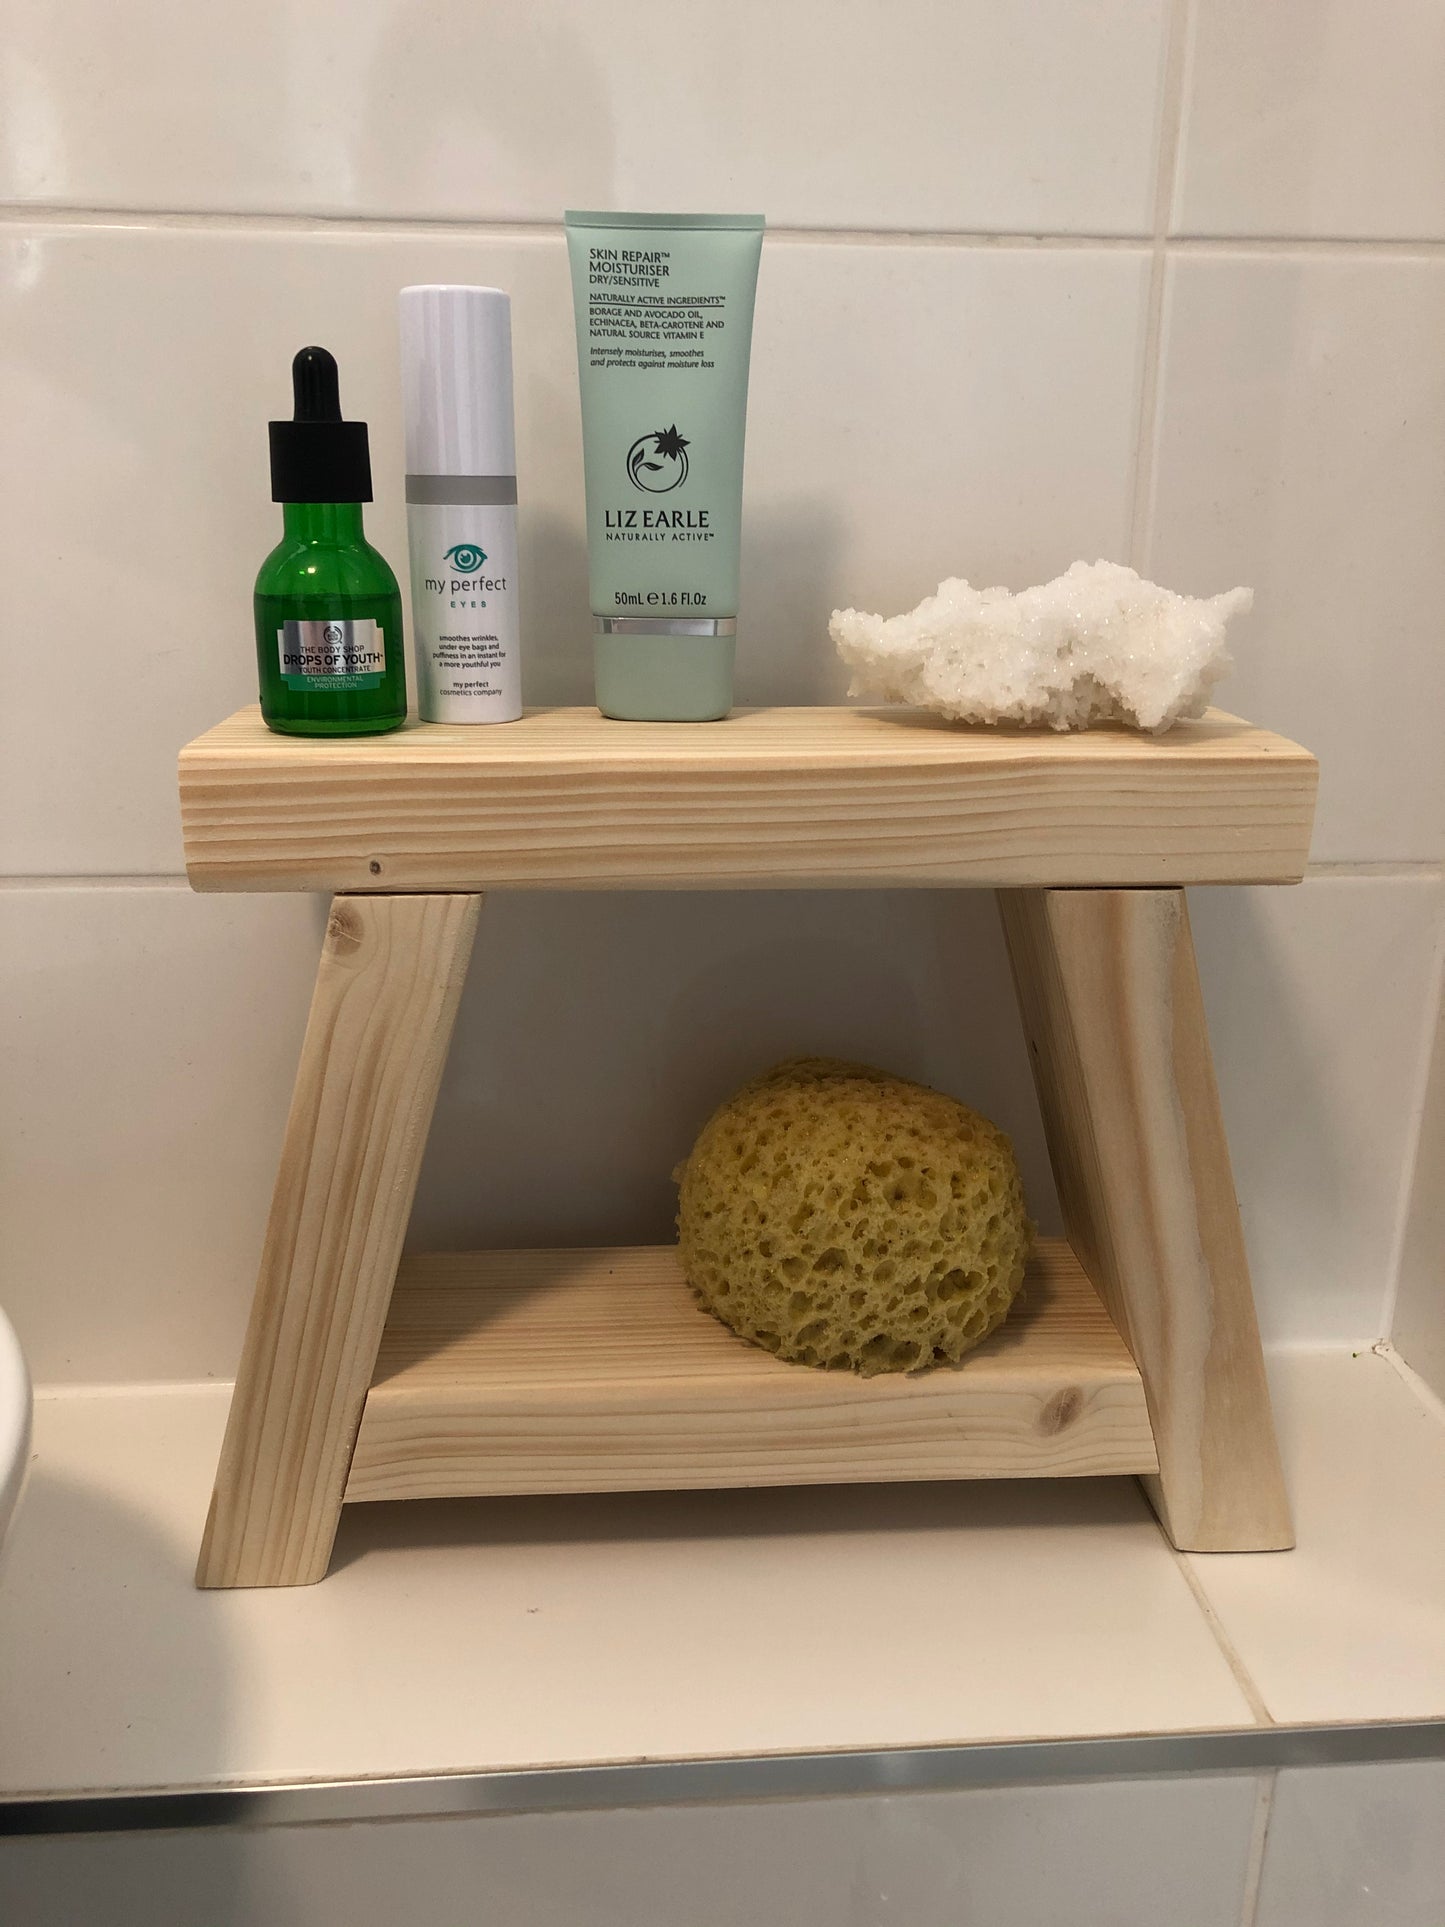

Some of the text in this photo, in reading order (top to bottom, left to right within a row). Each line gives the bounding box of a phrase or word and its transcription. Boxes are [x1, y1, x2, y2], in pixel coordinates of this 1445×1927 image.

[590, 248, 618, 260] SKIN
[589, 262, 670, 276] MOISTURISER
[589, 275, 660, 288] DRY/SENSITIVE
[589, 293, 635, 303] NATURALLY
[637, 296, 664, 304] ACTIVE
[589, 308, 622, 316] BORAGE
[590, 318, 637, 328] ECHINACEA,
[640, 321, 704, 329] BETA-CAROTENE
[590, 330, 627, 338] NATURAL
[628, 330, 660, 339] SOURCE
[590, 347, 623, 357] Intensely
[669, 350, 704, 358] smoothes
[590, 358, 714, 369] and protects against moisture loss
[605, 510, 709, 528] LIZ EARLE
[425, 576, 506, 595] my perfect
[615, 592, 644, 605] 50mL
[662, 592, 677, 605] 1.6
[284, 655, 322, 665] DROPS
[325, 655, 340, 665] OF
[462, 661, 489, 669] youthful
[323, 665, 371, 673] CONCENTRATE
